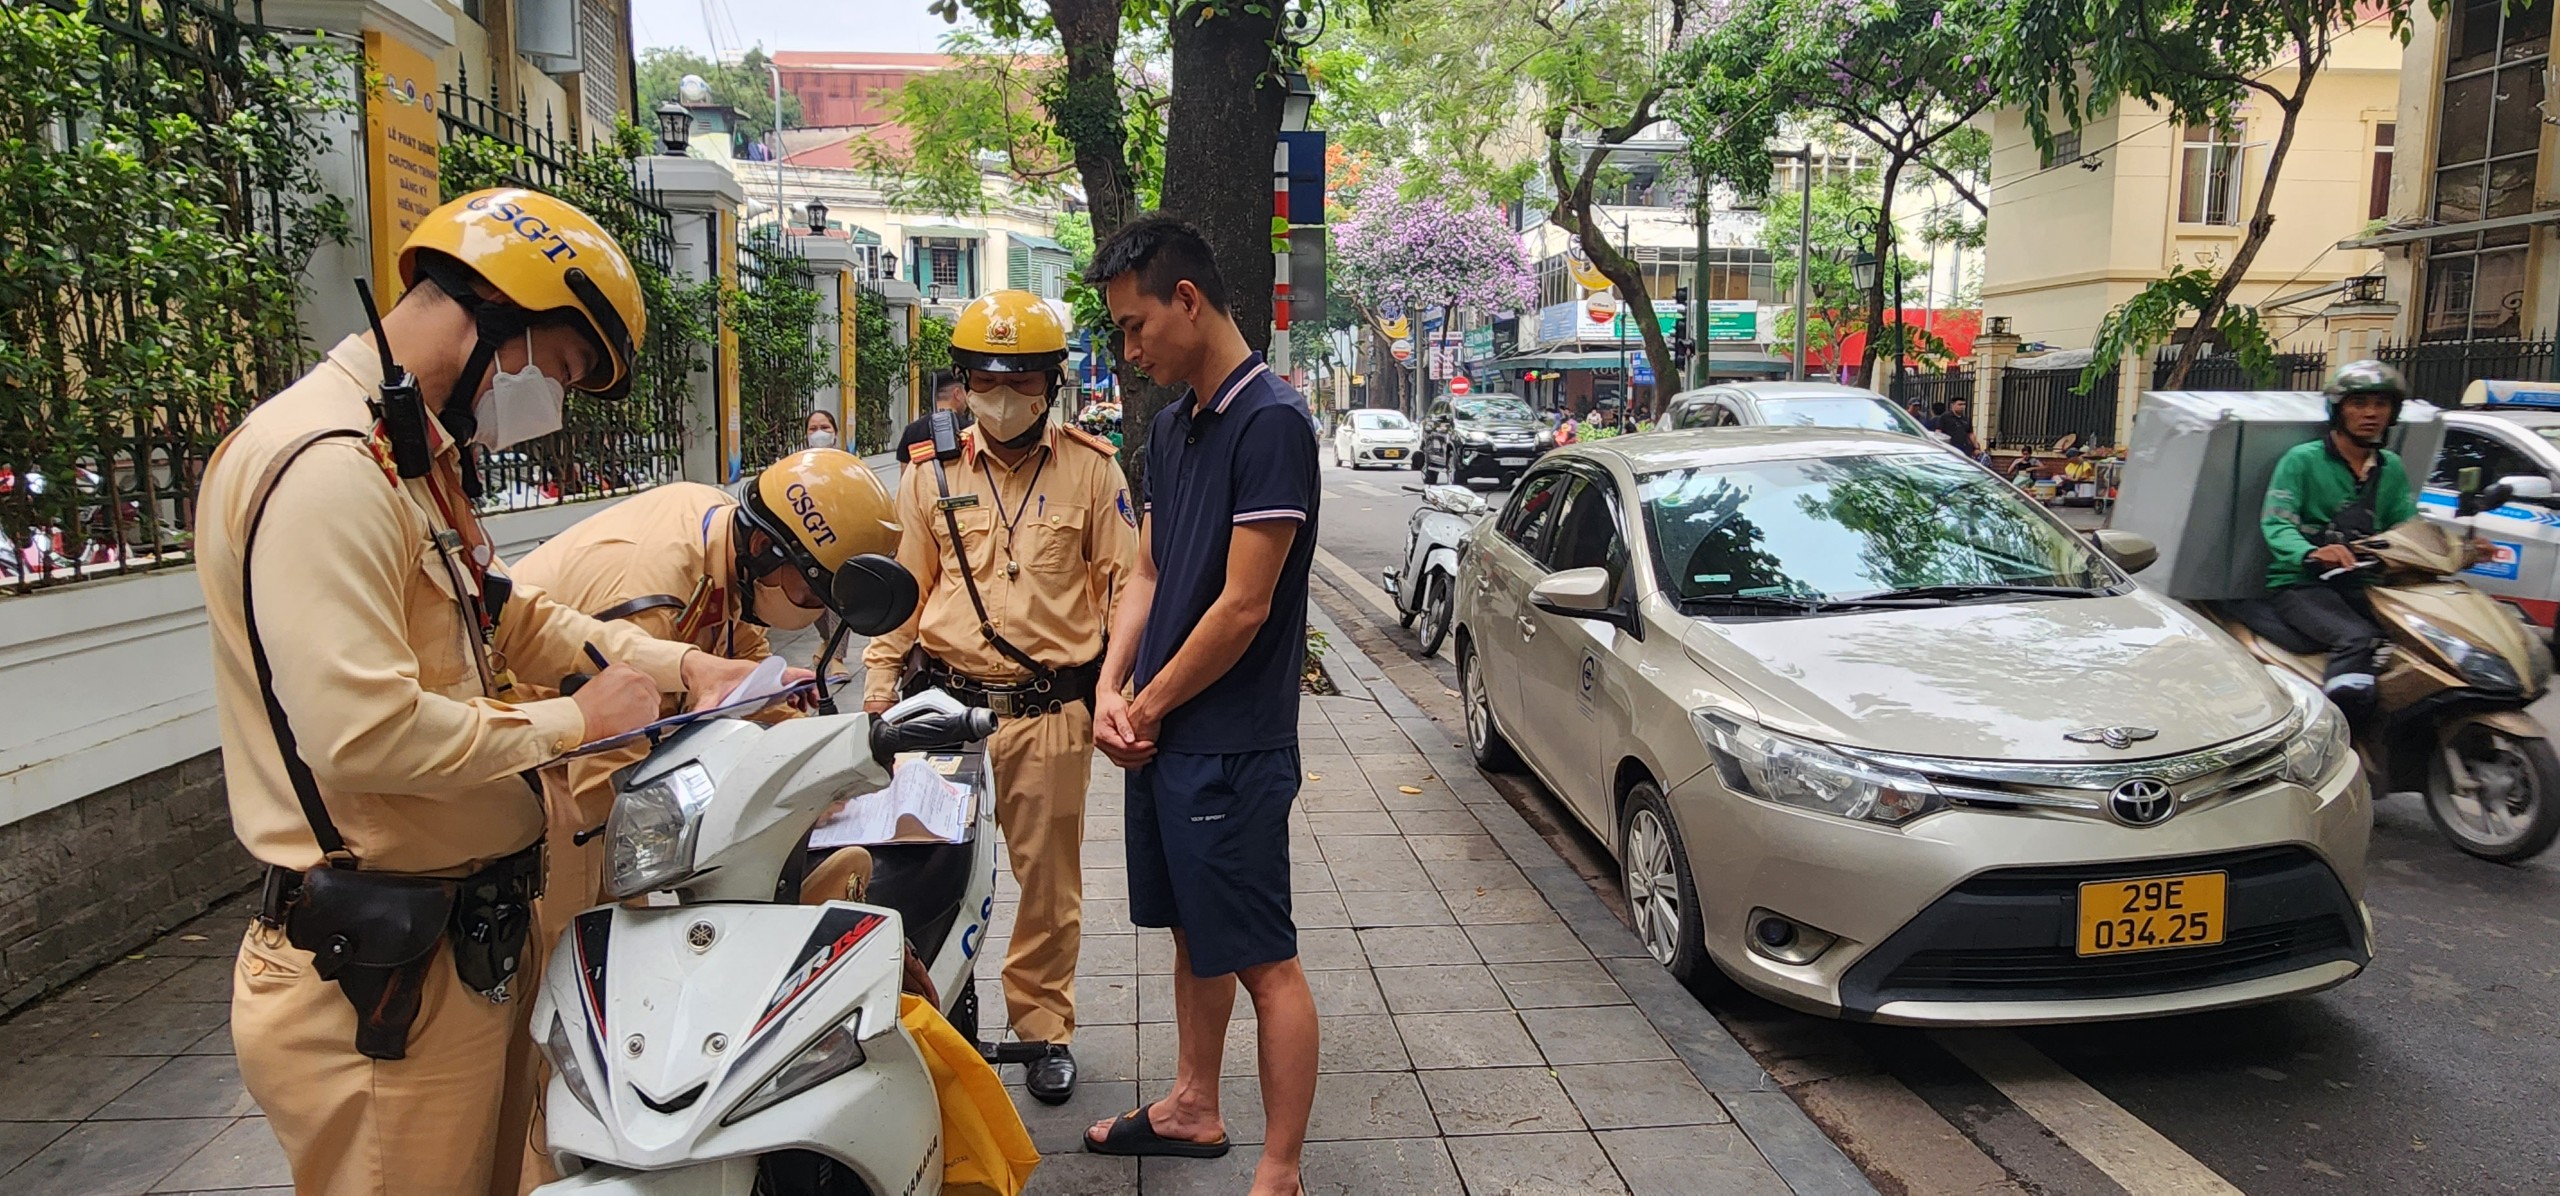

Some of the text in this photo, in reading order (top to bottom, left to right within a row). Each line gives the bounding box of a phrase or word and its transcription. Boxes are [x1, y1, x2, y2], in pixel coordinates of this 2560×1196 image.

[467, 196, 577, 264] CSGT
[786, 483, 837, 548] CSGT
[2122, 880, 2185, 914] 29E
[2095, 911, 2209, 950] 034.25
